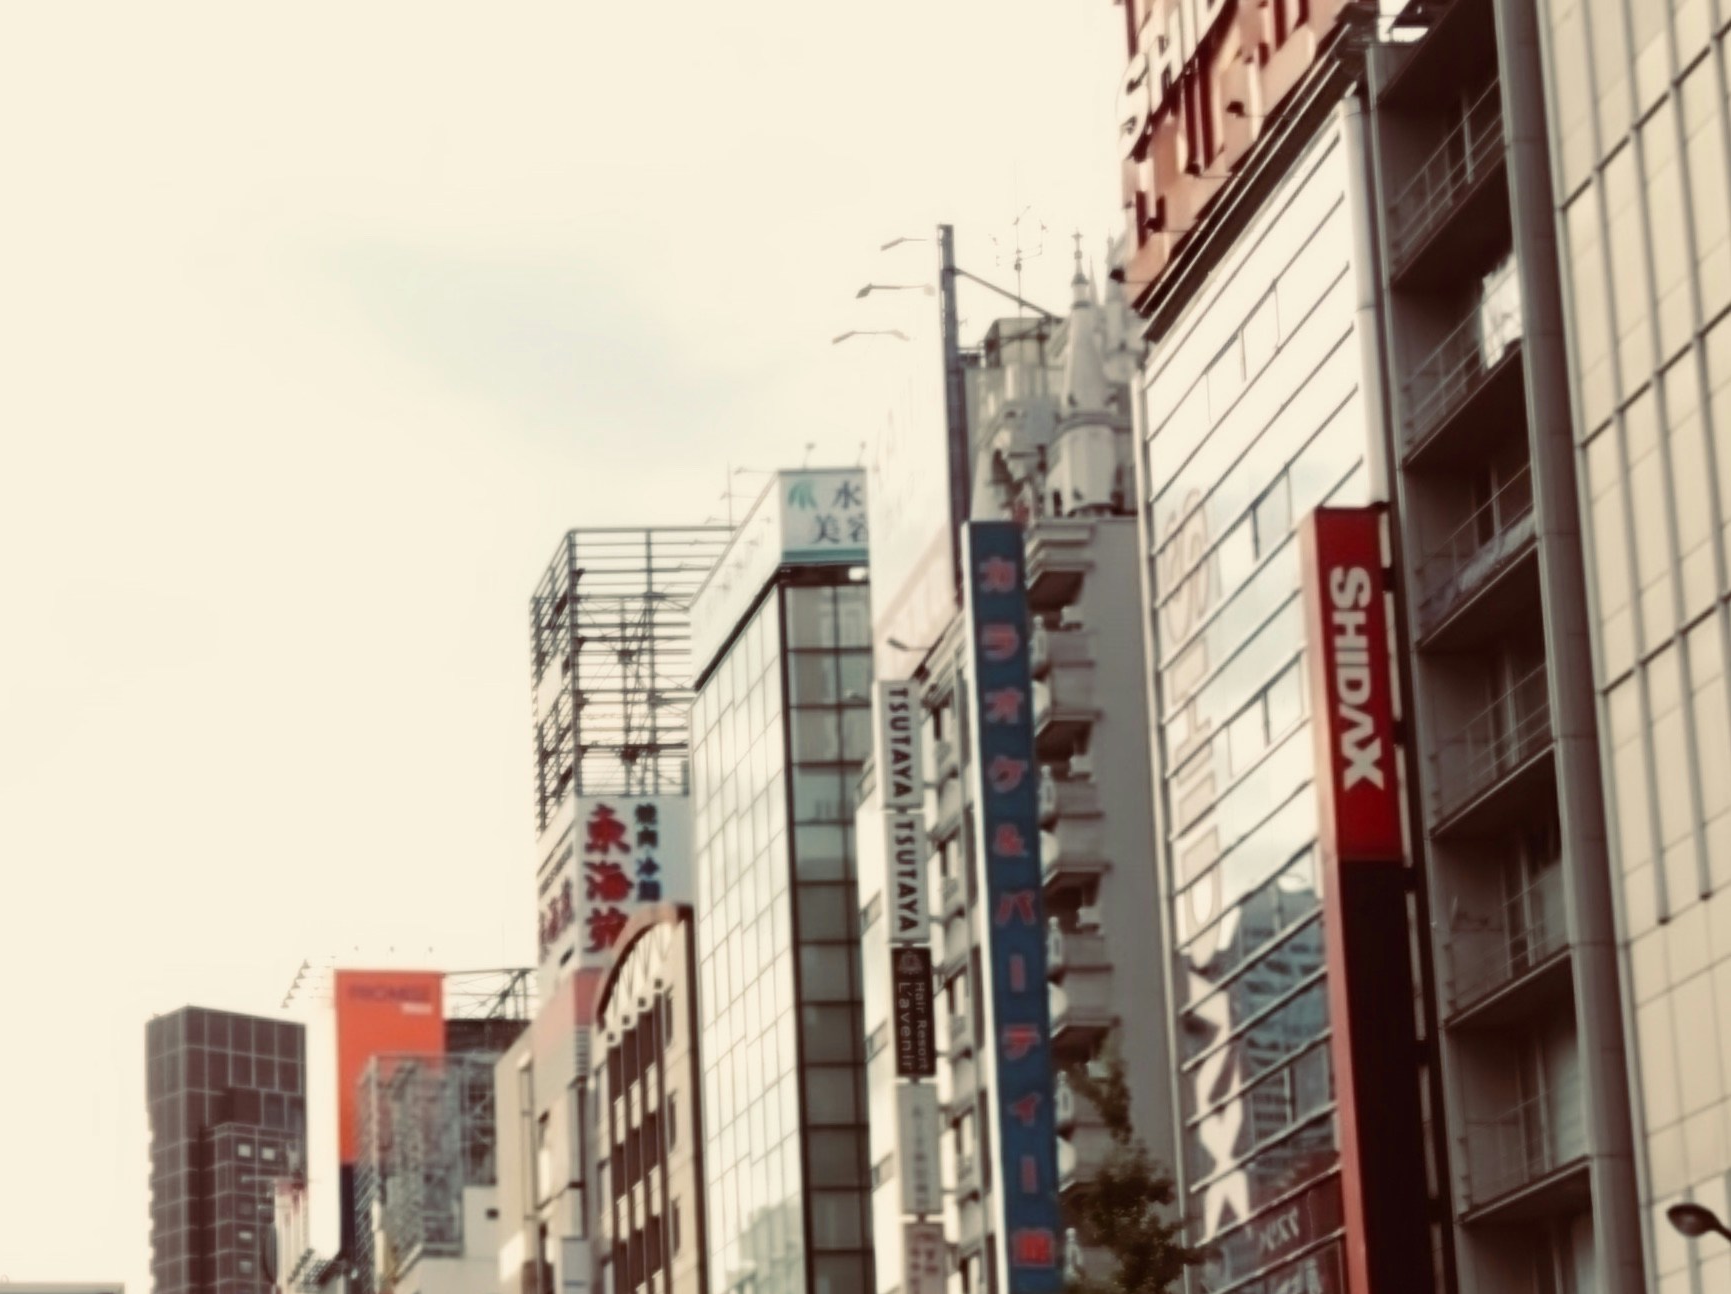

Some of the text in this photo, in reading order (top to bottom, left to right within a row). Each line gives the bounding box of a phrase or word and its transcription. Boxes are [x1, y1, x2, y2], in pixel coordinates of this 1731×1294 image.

[1329, 565, 1385, 792] SHIDAX
[888, 686, 914, 798] TSUTAYA
[895, 820, 919, 932] TSUTAYA
